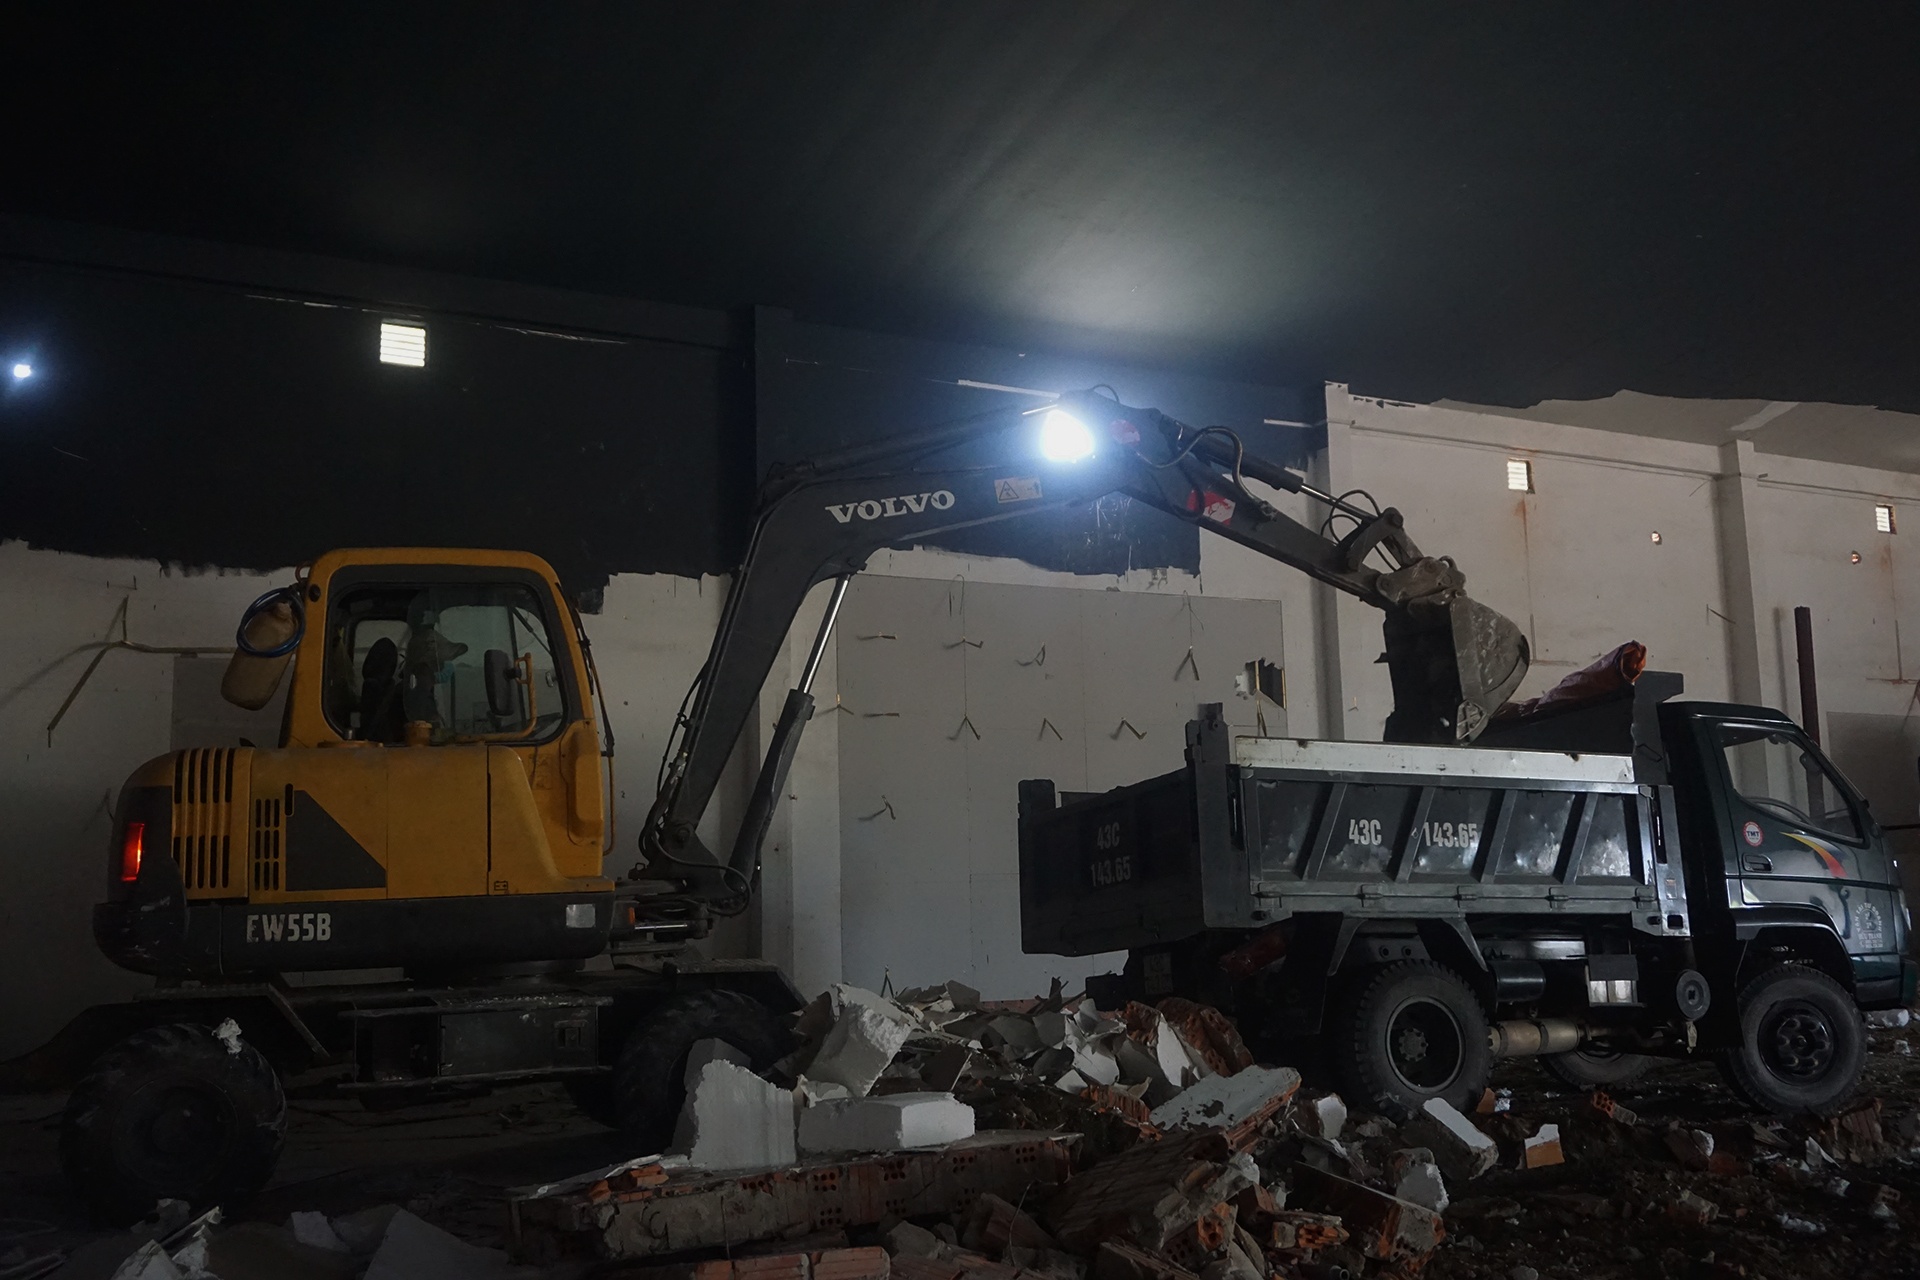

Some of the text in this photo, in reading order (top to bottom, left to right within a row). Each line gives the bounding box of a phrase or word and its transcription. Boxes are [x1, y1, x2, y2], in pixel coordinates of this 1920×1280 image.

[825, 490, 955, 524] VOLVO
[1097, 821, 1120, 850] 43C
[1348, 818, 1479, 848] 43C 143.65
[1091, 856, 1131, 887] 143.65
[246, 912, 332, 943] EW55B
